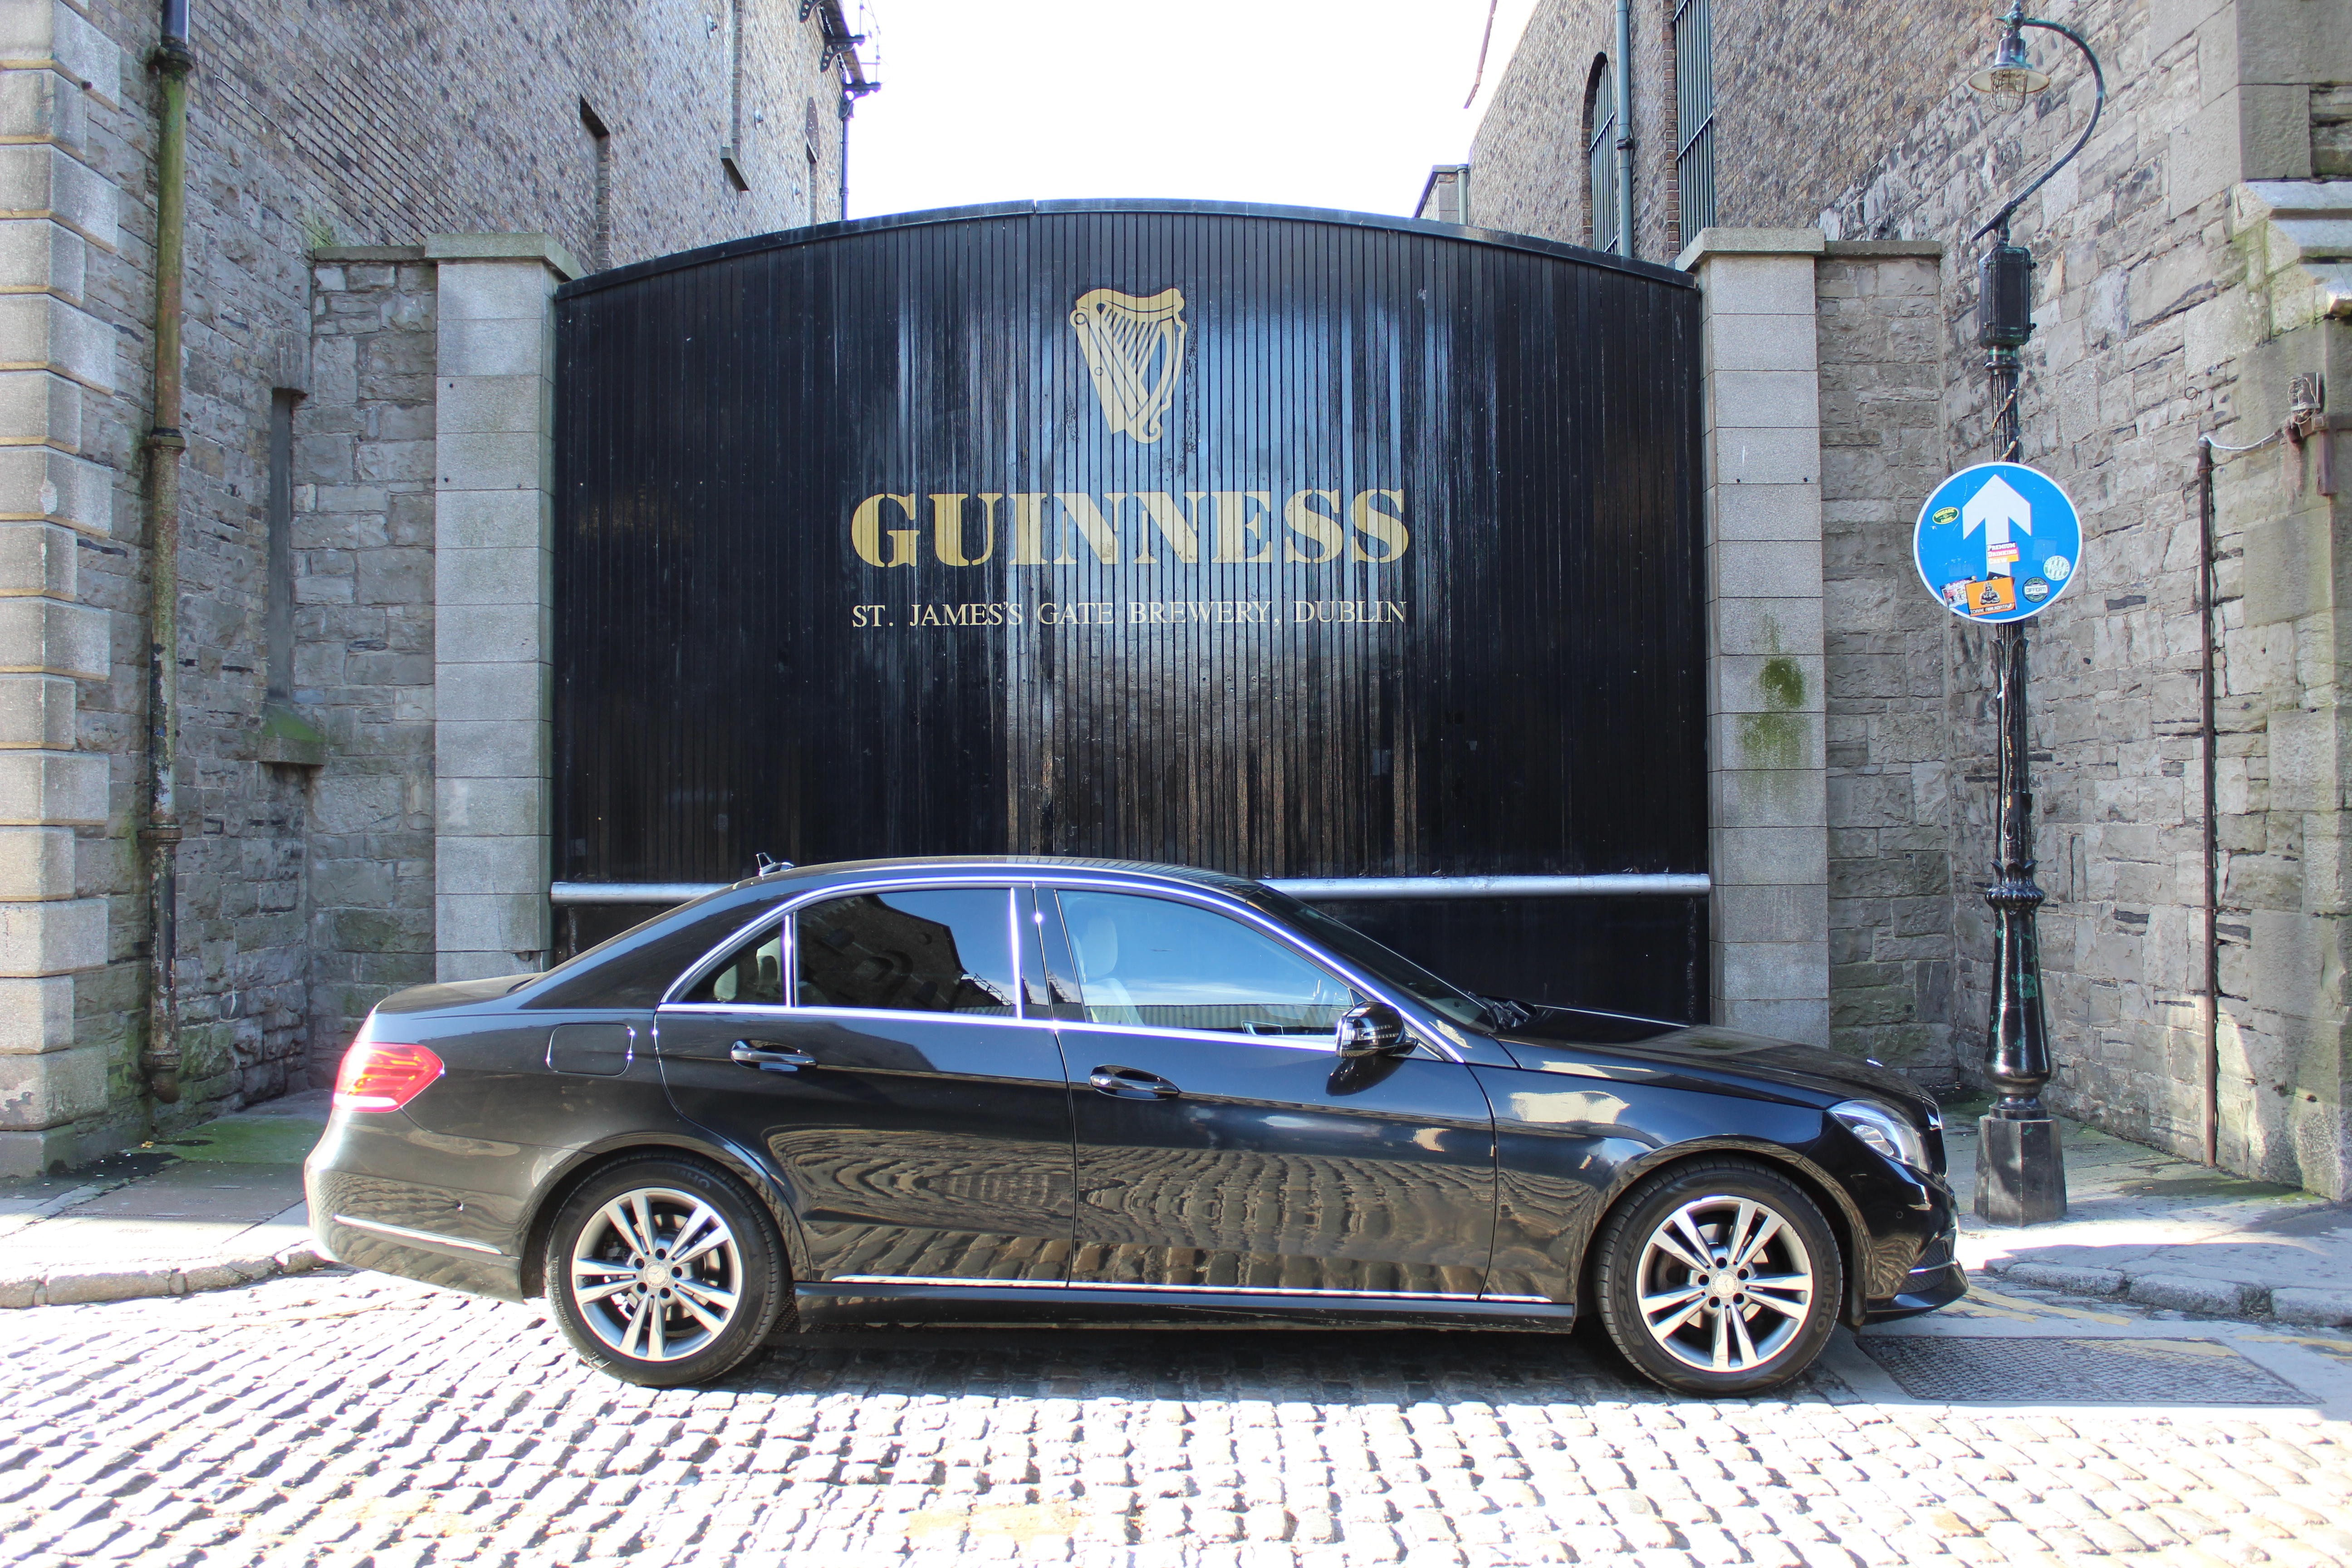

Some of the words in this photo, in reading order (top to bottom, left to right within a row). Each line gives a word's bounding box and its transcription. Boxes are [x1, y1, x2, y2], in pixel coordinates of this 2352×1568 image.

[1934, 508, 1955, 518] BRIGADE
[851, 489, 1409, 568] GUINNESS
[1987, 542, 2016, 551] PREMIUM
[1988, 549, 2017, 558] DRINKING
[852, 605, 892, 627] ST.
[909, 601, 1023, 627] JAMES'S
[1037, 602, 1114, 626] GATE
[1128, 601, 1279, 627] BREWERY,
[1293, 601, 1407, 623] DUBLIN
[1627, 1237, 1636, 1252] LE
[1815, 1238, 1835, 1333] KUMHO
